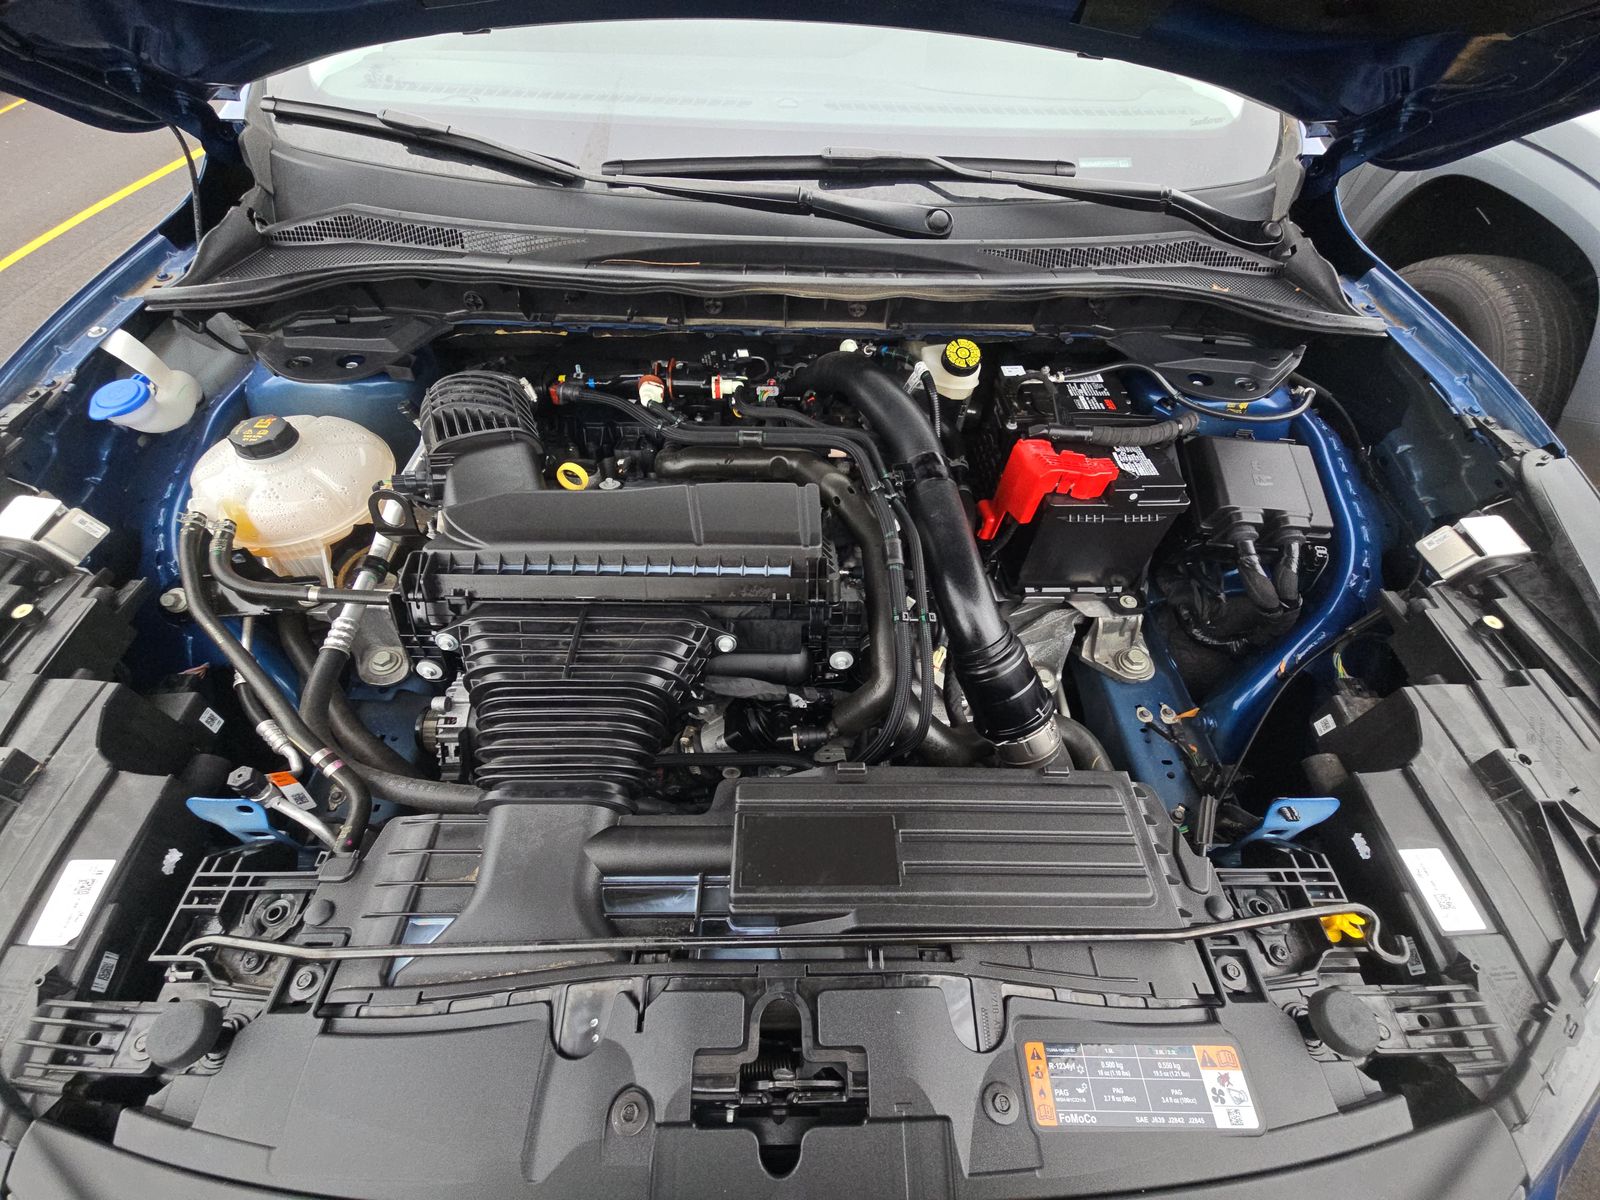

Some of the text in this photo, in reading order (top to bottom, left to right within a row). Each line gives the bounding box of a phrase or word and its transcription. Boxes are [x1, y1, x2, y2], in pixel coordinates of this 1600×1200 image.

[1048, 1062, 1076, 1072] R-1234yf
[1054, 1089, 1069, 1097] PAG
[1059, 1113, 1097, 1123] FoMoCo
